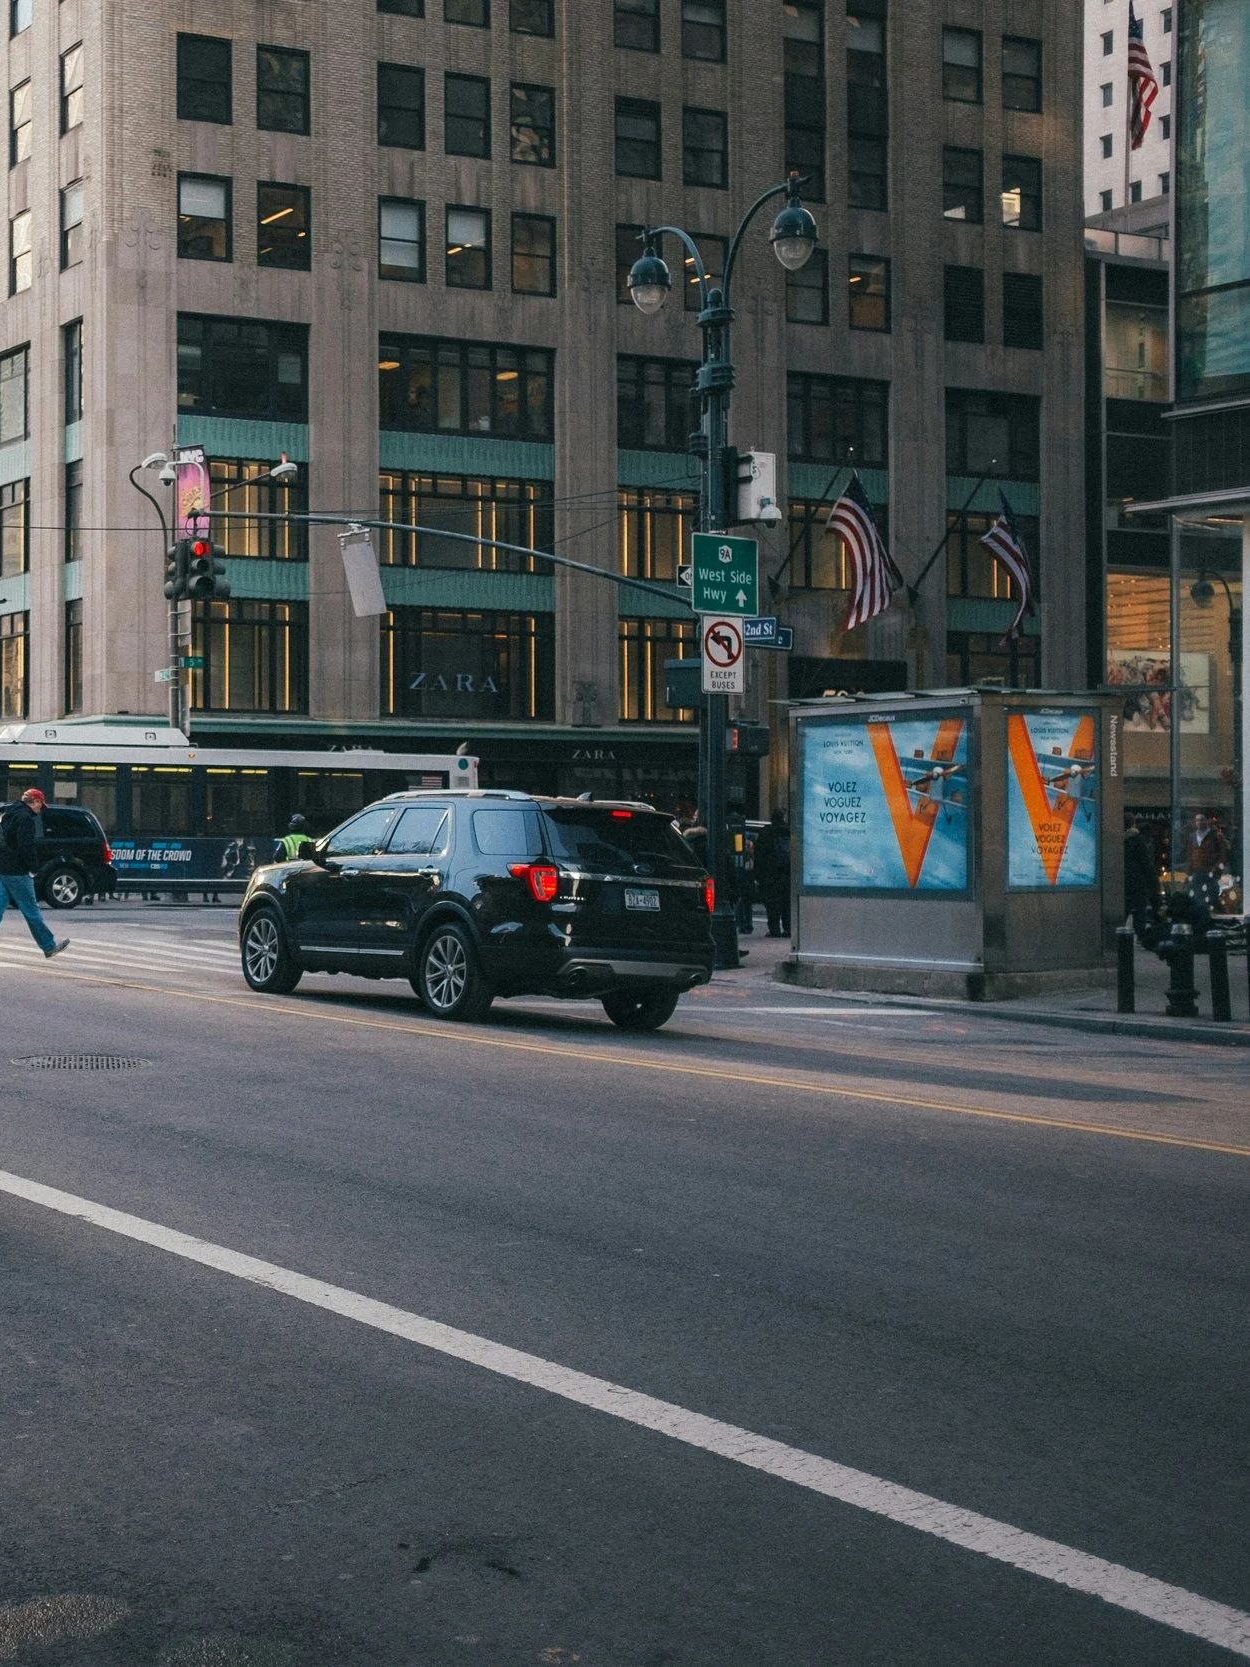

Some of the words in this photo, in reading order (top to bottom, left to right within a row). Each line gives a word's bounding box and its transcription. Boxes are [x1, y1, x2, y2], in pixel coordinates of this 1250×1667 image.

[720, 548, 731, 559] 9A
[699, 568, 725, 582] West
[730, 570, 752, 584] Side
[703, 587, 727, 603] Hwy
[744, 623, 761, 635] 2nd
[763, 624, 773, 635] St
[710, 671, 736, 680] EXCEPT
[409, 672, 498, 693] ZARA
[711, 681, 735, 689] BUSES
[1110, 715, 1118, 777] Newsstand
[572, 750, 616, 760] ZARA
[828, 781, 857, 793] VOLEZ
[824, 796, 862, 808] VOGUEZ
[819, 812, 866, 824] VOYAGEZ
[1038, 823, 1062, 832] VOLEZ
[1035, 834, 1066, 843] VOGUEZ
[111, 849, 135, 861] SDOM
[136, 849, 146, 861] OF
[147, 849, 162, 861] THE
[163, 849, 192, 862] CROWD
[1030, 846, 1068, 854] VOYAGEZ
